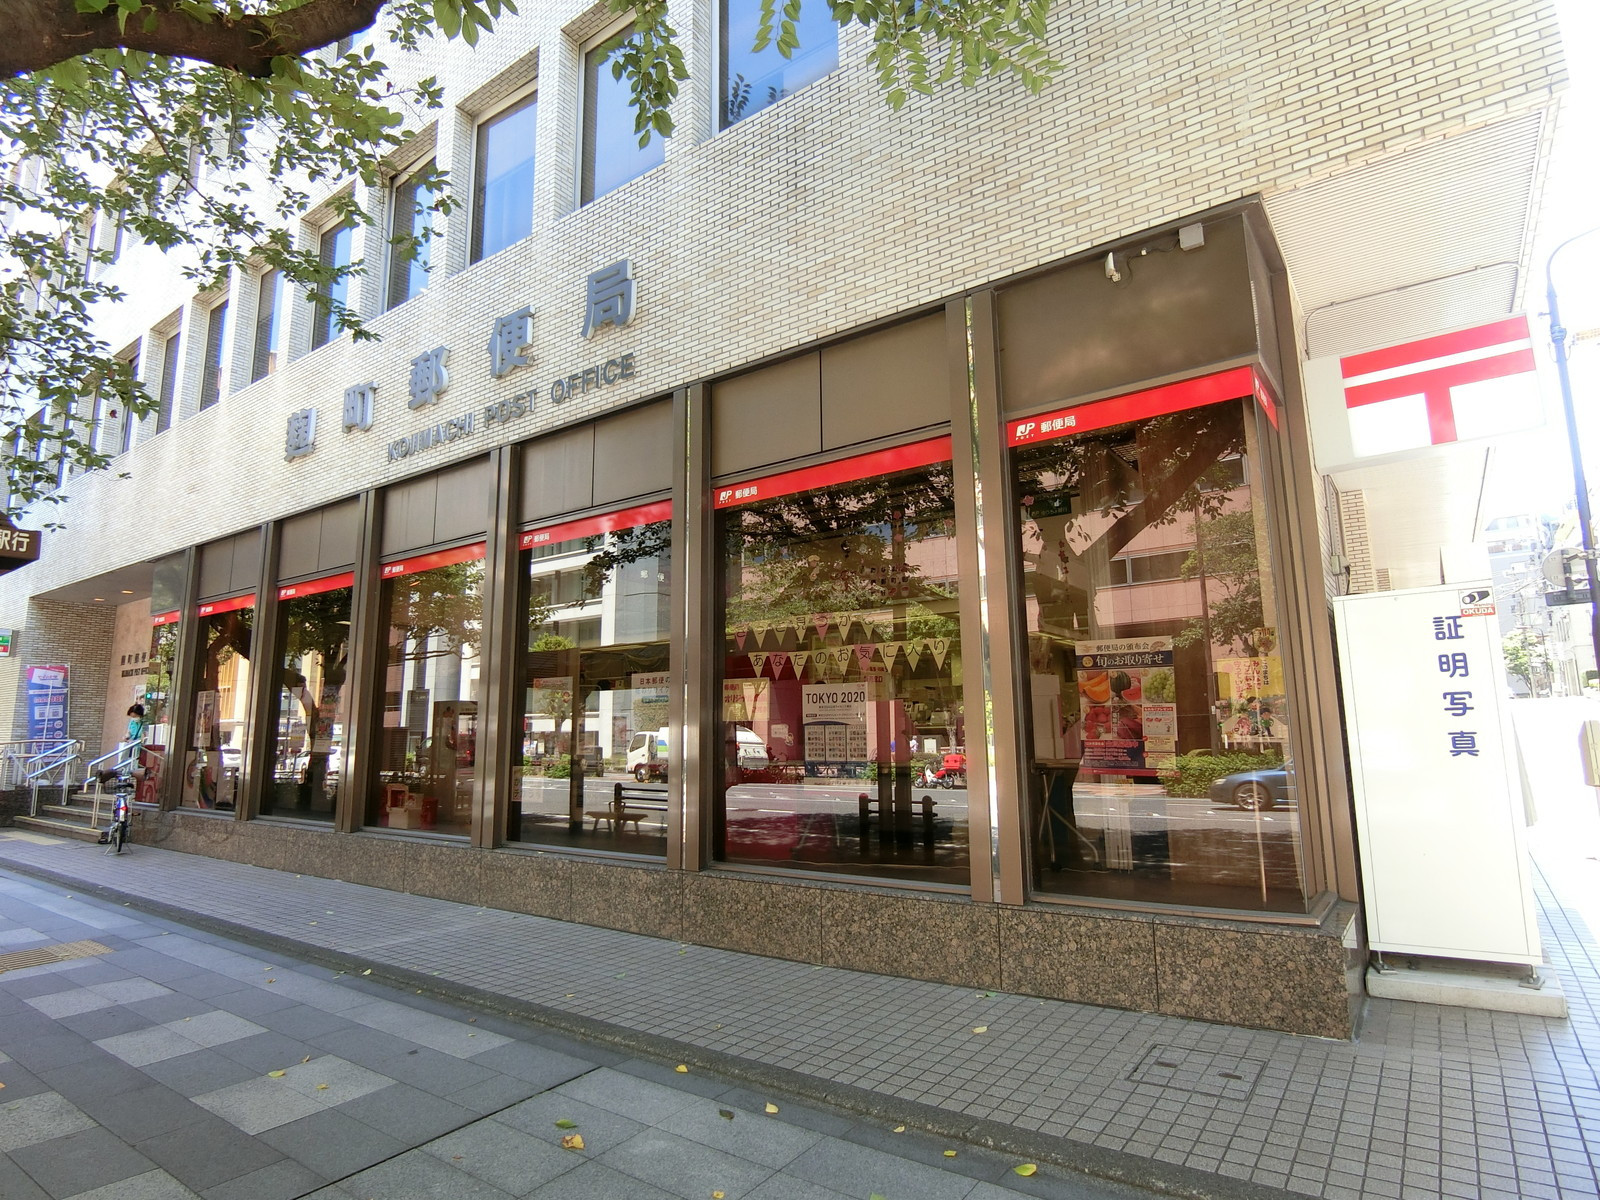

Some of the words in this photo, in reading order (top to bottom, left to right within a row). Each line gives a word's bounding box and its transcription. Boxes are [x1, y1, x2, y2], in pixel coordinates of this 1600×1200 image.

[387, 411, 475, 463] KOJIMACHI
[484, 388, 539, 429] POST
[550, 351, 638, 404] OFFICE
[1040, 415, 1076, 434] 郵便局
[734, 485, 758, 500] 郵便局
[1462, 606, 1495, 616] OKUDA
[752, 639, 945, 667] あなたのお気に入り
[1095, 641, 1150, 653] 郵便局の頒布会
[1095, 653, 1165, 668] 旬のお取り寄せ
[1432, 615, 1480, 757] 証明写真
[805, 691, 839, 705] TOKYO
[840, 690, 866, 704] 2020
